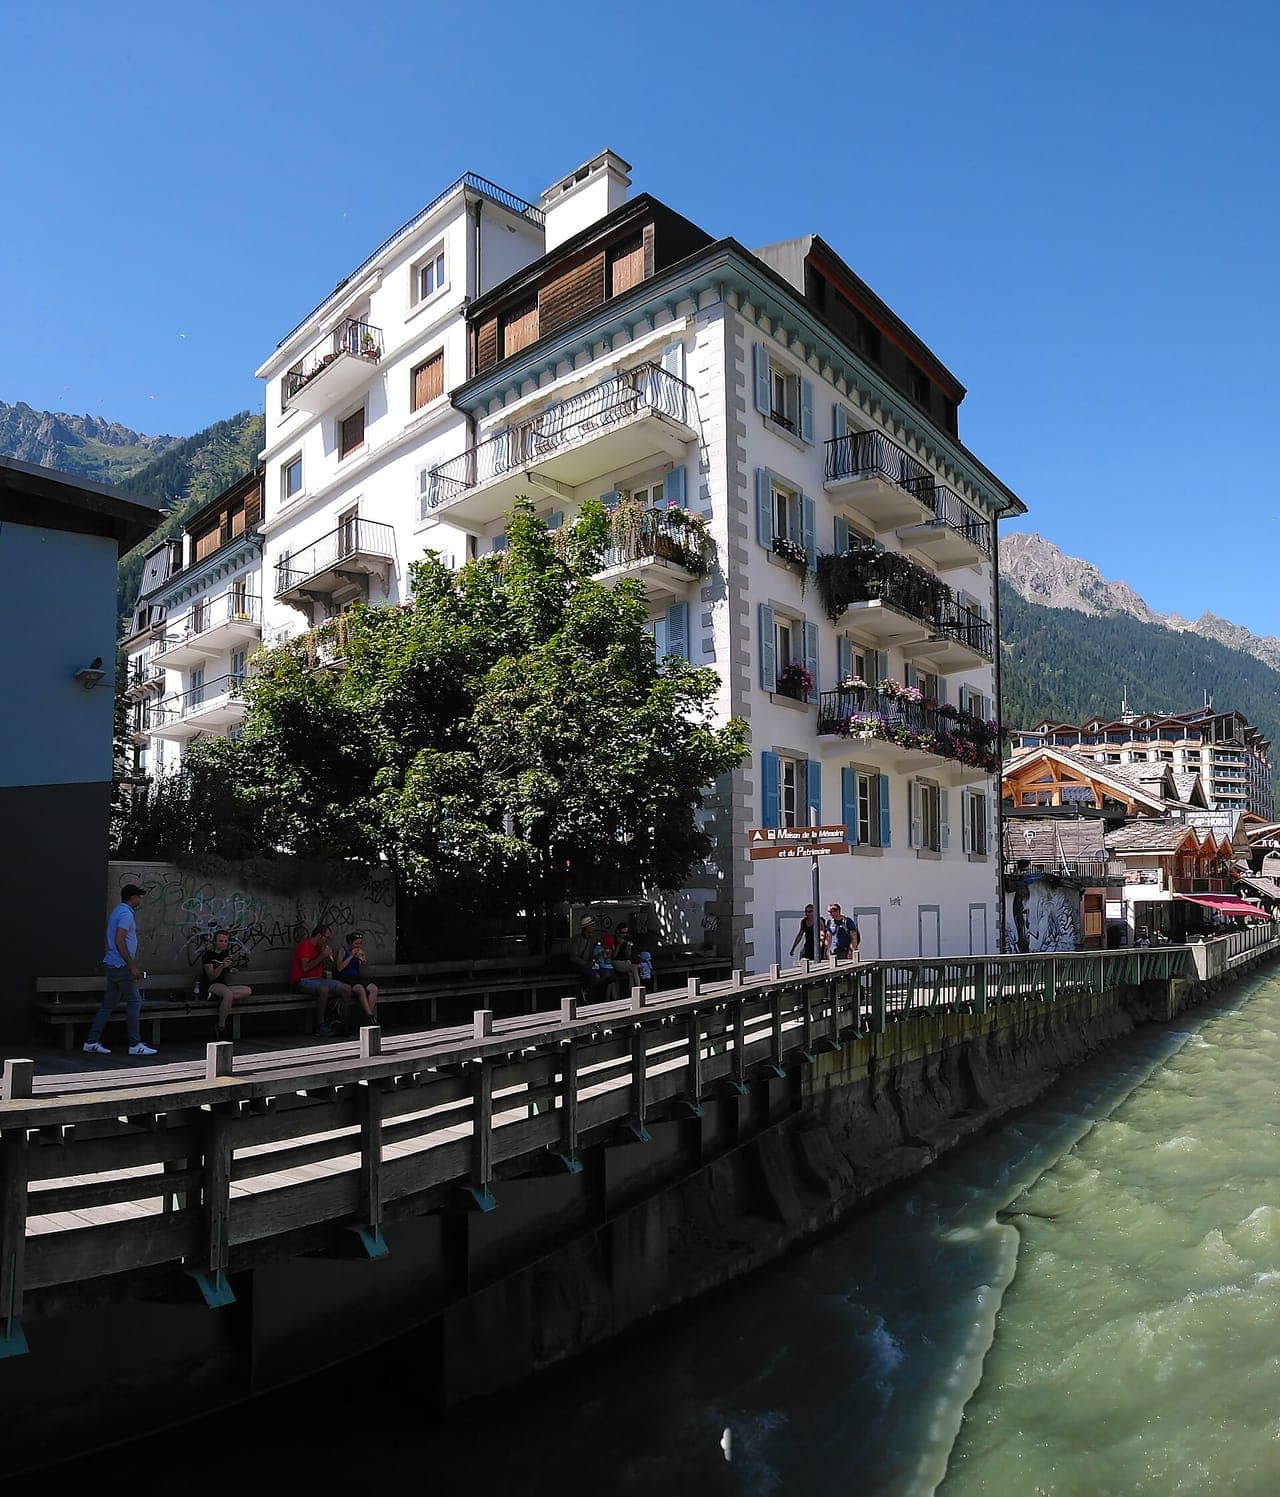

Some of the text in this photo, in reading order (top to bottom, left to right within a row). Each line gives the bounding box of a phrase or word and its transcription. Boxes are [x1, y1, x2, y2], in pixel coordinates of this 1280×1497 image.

[1188, 818, 1229, 827] CAP-HORN
[777, 829, 801, 839] Maison
[811, 830, 817, 838] la
[818, 829, 844, 838] Mémoire
[787, 849, 796, 857] du
[796, 846, 831, 857] Patrimoine
